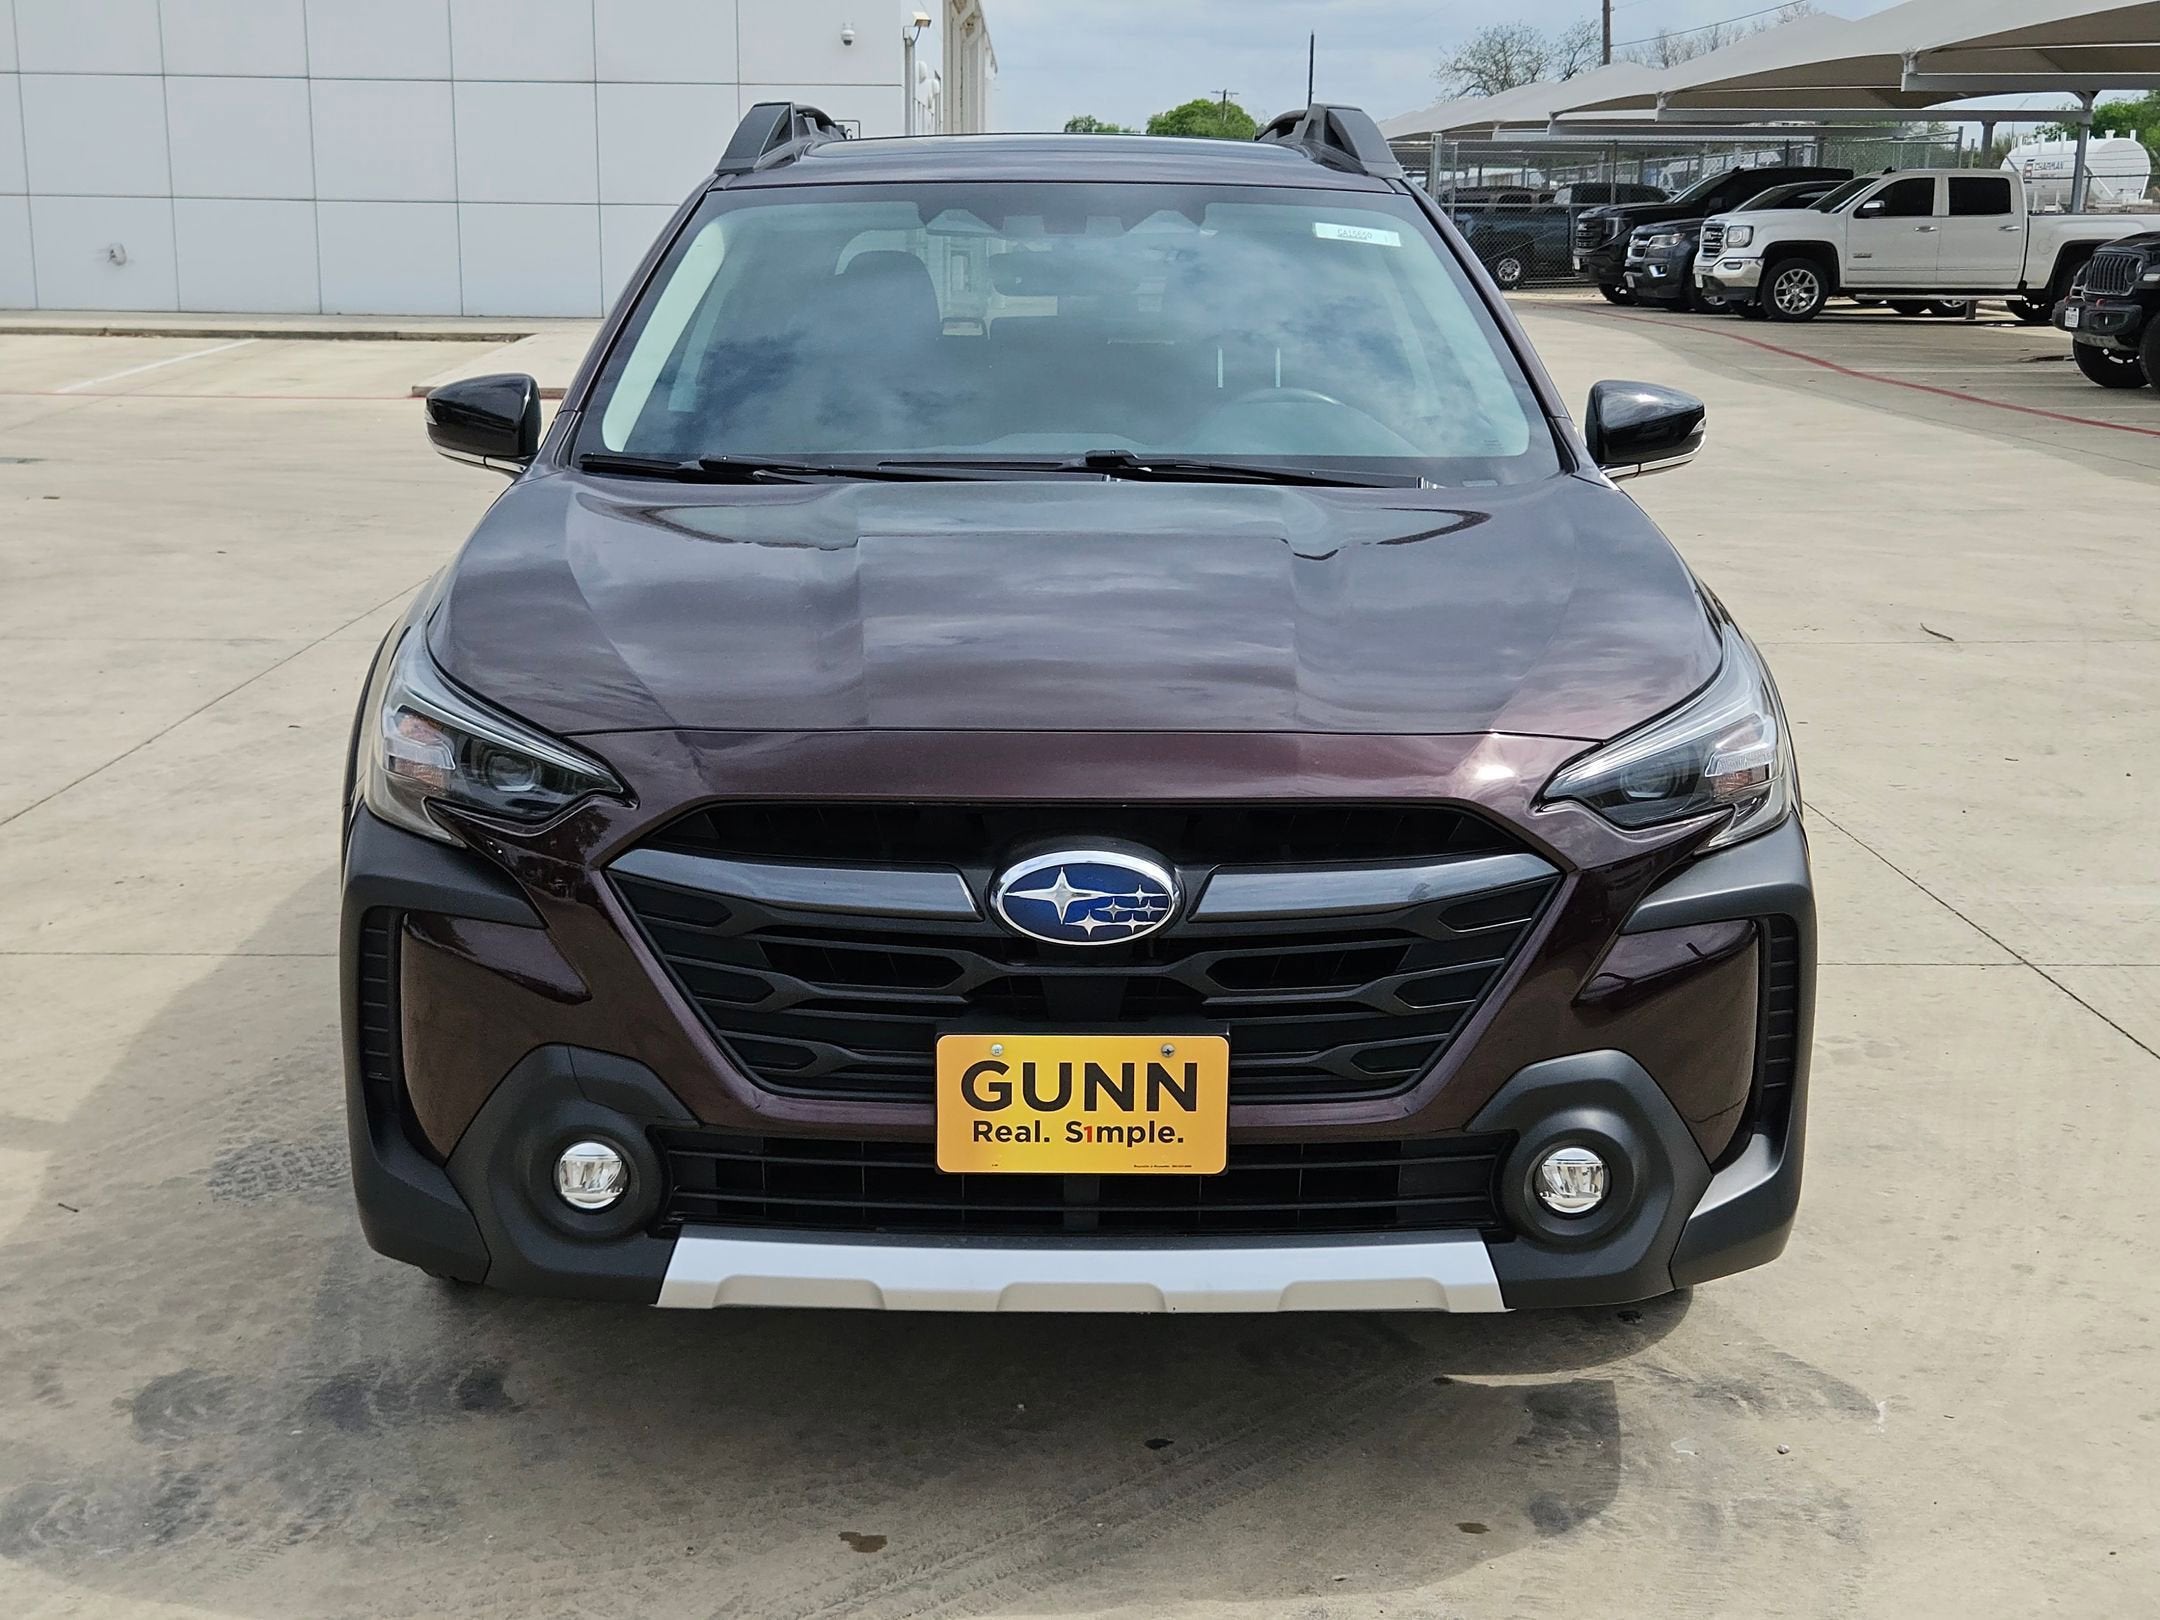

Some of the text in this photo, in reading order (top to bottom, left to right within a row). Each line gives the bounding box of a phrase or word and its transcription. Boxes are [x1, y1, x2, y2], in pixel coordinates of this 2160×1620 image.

[960, 1060, 1198, 1112] GUNN
[973, 1120, 1185, 1148] Real. S1mple.
